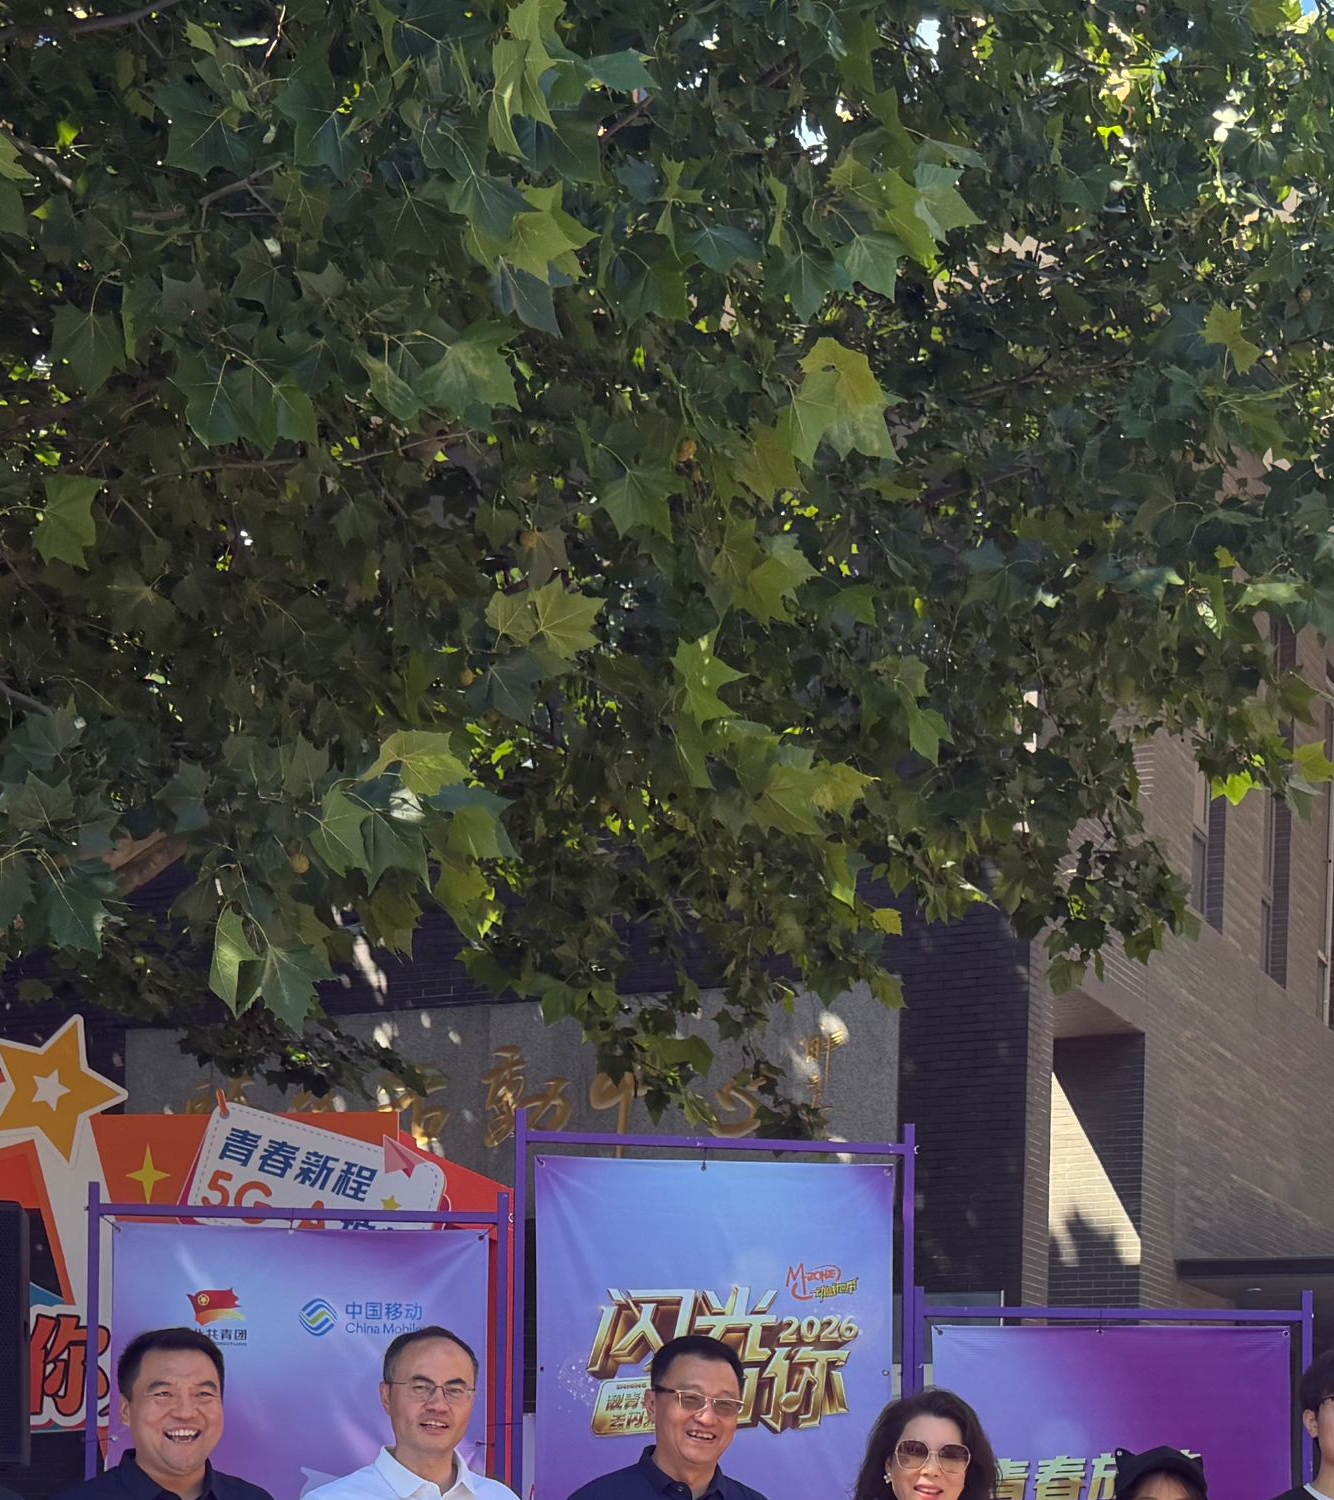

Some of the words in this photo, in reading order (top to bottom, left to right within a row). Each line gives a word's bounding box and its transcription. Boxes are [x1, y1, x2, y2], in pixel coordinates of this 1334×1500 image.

[218, 1127, 378, 1202] 青春新程
[345, 1301, 423, 1321] 中国移动
[345, 1321, 380, 1335] China
[778, 1314, 861, 1344] 2026
